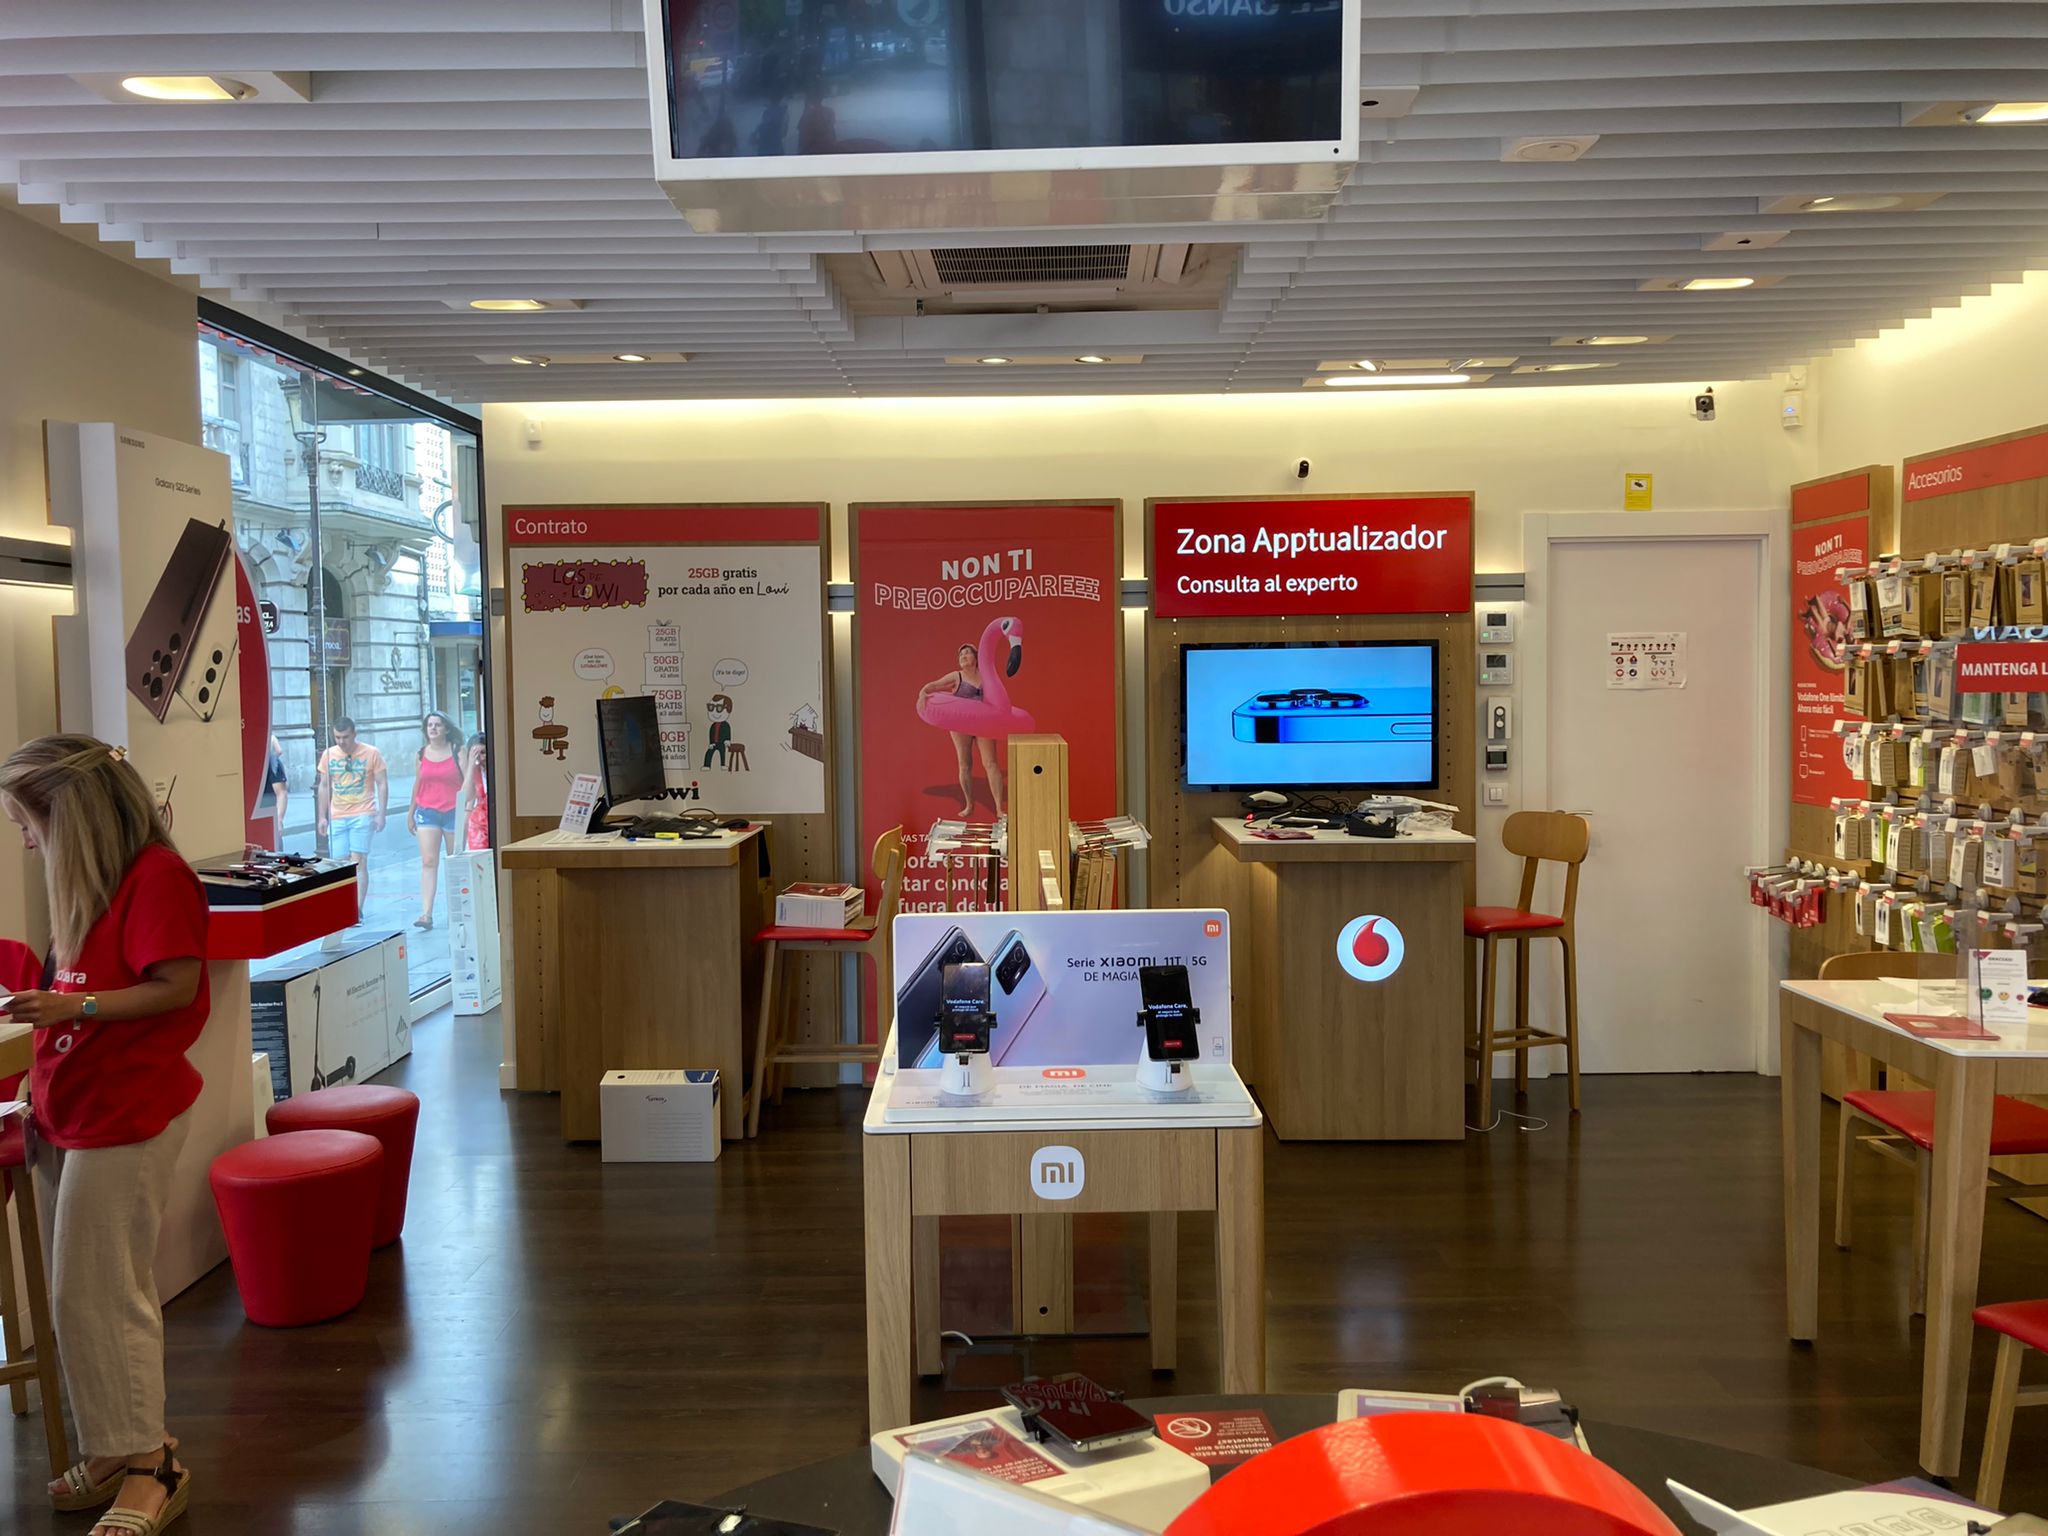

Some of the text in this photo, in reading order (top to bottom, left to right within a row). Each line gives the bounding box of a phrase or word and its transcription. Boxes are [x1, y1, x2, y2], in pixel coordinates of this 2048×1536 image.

[1908, 464, 1963, 490] Accesorios
[515, 518, 588, 535] Contrato
[1176, 524, 1448, 559] Zona Apptualizador
[1815, 534, 1843, 557] NON TI
[942, 549, 1032, 580] NON TI
[688, 567, 757, 581] 25GB gratis
[658, 586, 679, 598] por
[681, 583, 711, 595] cada
[713, 584, 737, 595] año
[739, 586, 754, 595] en
[1177, 574, 1358, 595] Consulta al experto
[653, 656, 679, 665] 50GB
[1961, 662, 2038, 676] MANTENGA
[655, 702, 682, 710] RATIS
[900, 834, 919, 843] VAS
[898, 898, 946, 913] fuera
[1067, 957, 1095, 968] Serie
[1164, 956, 1182, 966] 11T
[1191, 956, 1207, 966] 5G
[1084, 972, 1098, 981] DE
